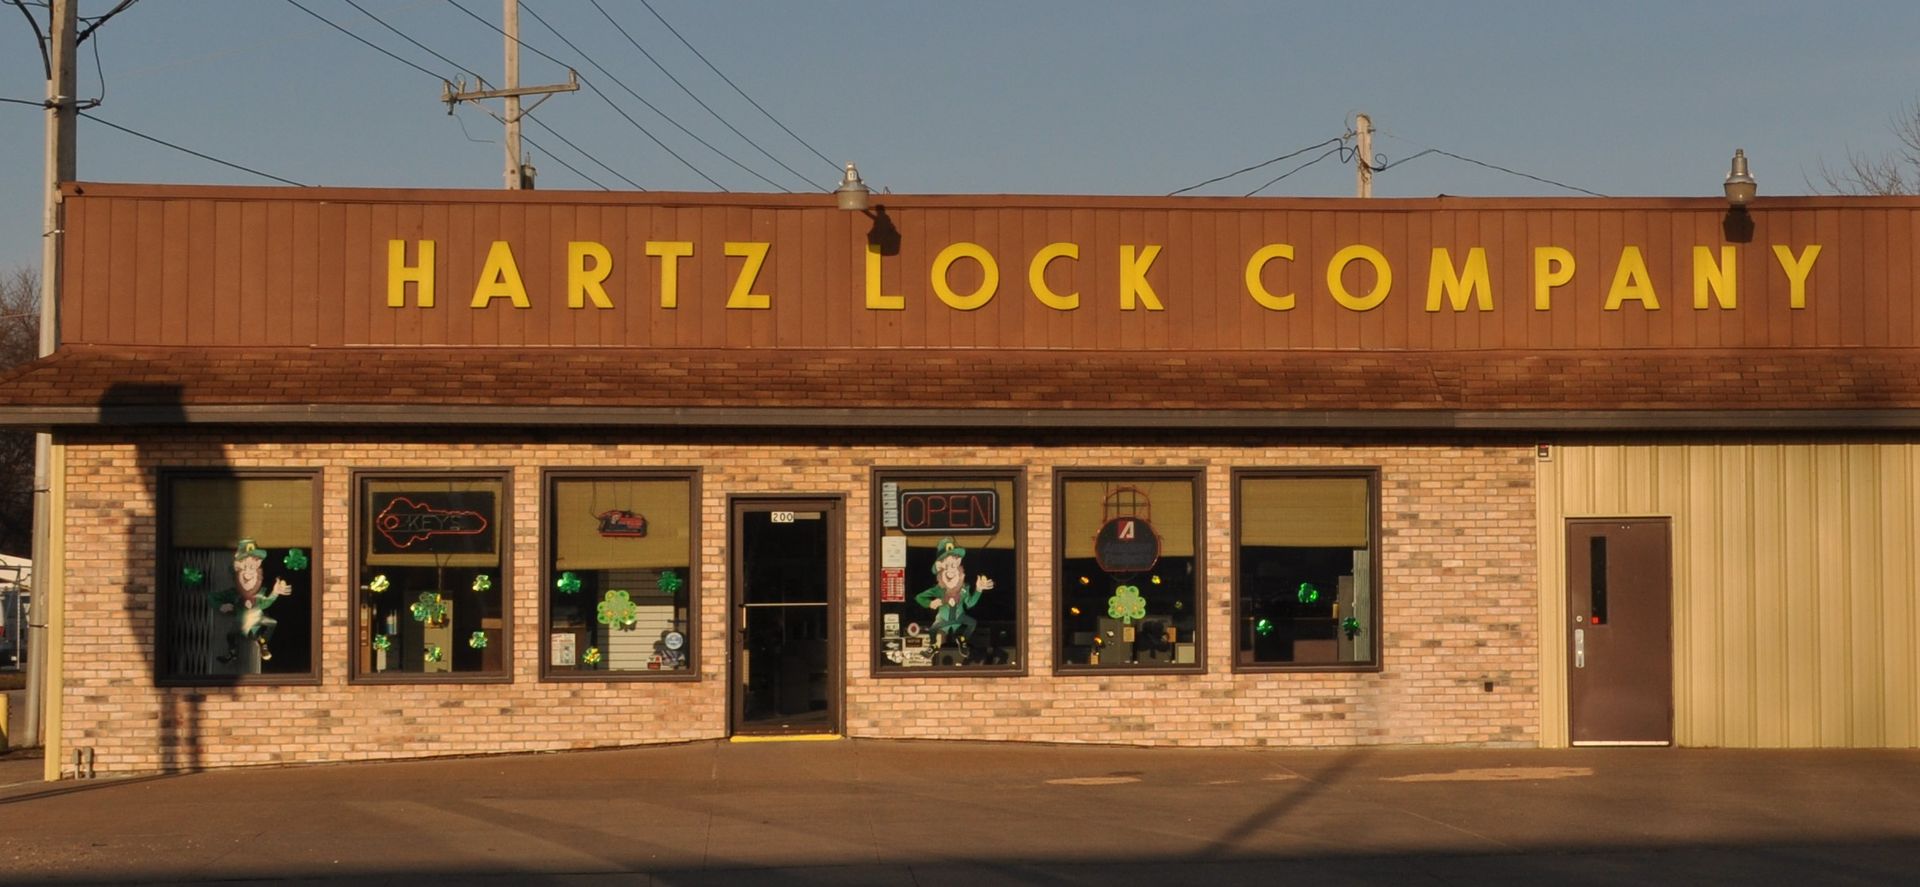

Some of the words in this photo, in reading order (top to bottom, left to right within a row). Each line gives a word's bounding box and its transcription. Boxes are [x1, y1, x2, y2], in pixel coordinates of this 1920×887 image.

[387, 239, 772, 309] HARTZ
[866, 243, 1163, 310] LOCK
[1246, 244, 1824, 311] COMPANY
[408, 514, 460, 530] KEYS
[773, 513, 793, 522] 200
[904, 495, 992, 527] OPEN
